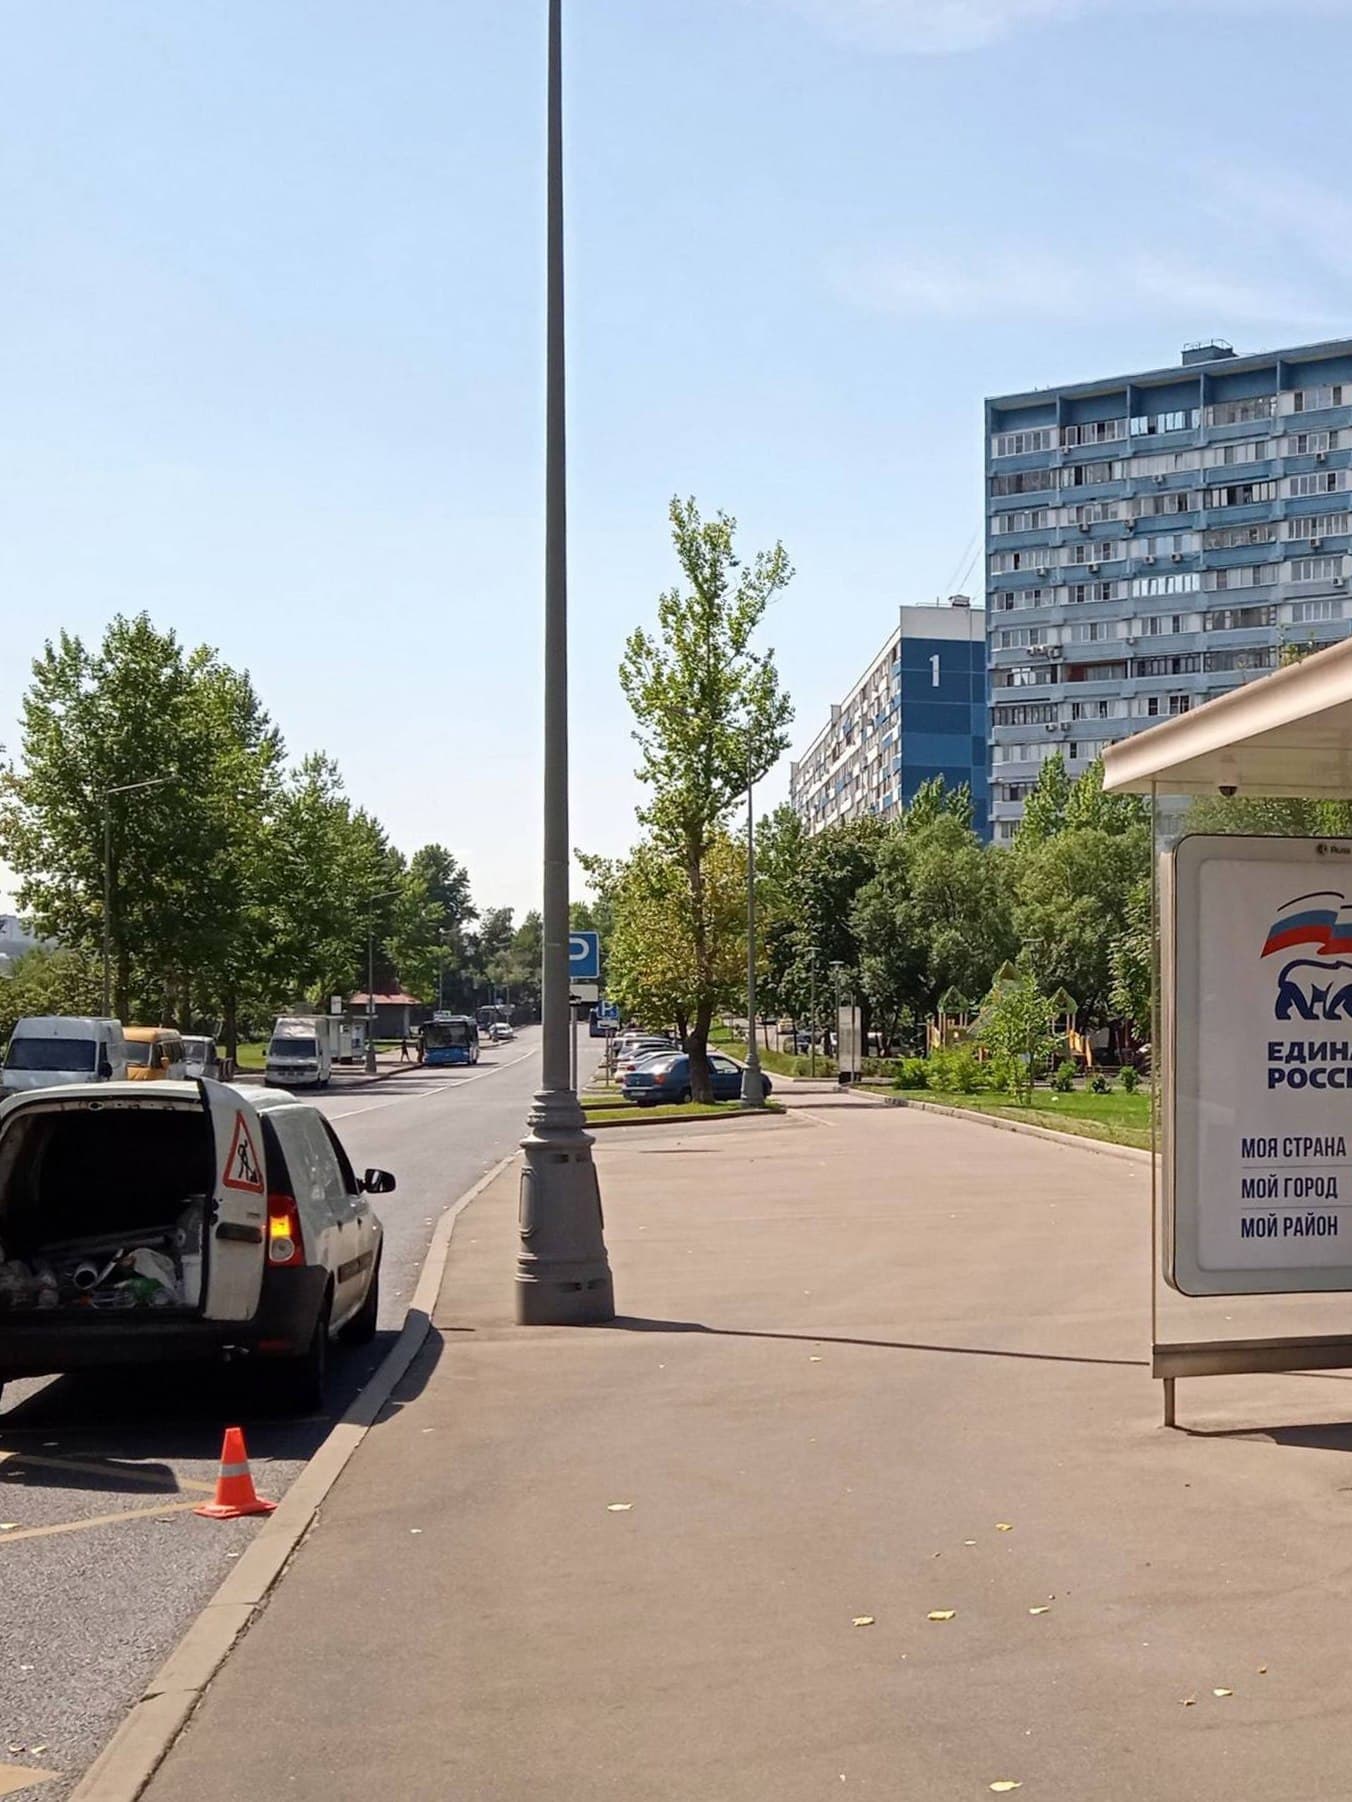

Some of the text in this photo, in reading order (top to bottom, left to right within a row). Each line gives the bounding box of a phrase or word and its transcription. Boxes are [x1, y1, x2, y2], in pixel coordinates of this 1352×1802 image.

[929, 655, 939, 687] 1
[1241, 1137, 1277, 1159] МОЯ
[1283, 1136, 1347, 1158] СТРАНА
[1241, 1173, 1279, 1199] МОЙ
[1284, 1176, 1337, 1200] ГОРОД
[1241, 1212, 1278, 1239] МОЙ
[1283, 1211, 1338, 1237] РАЙОН
